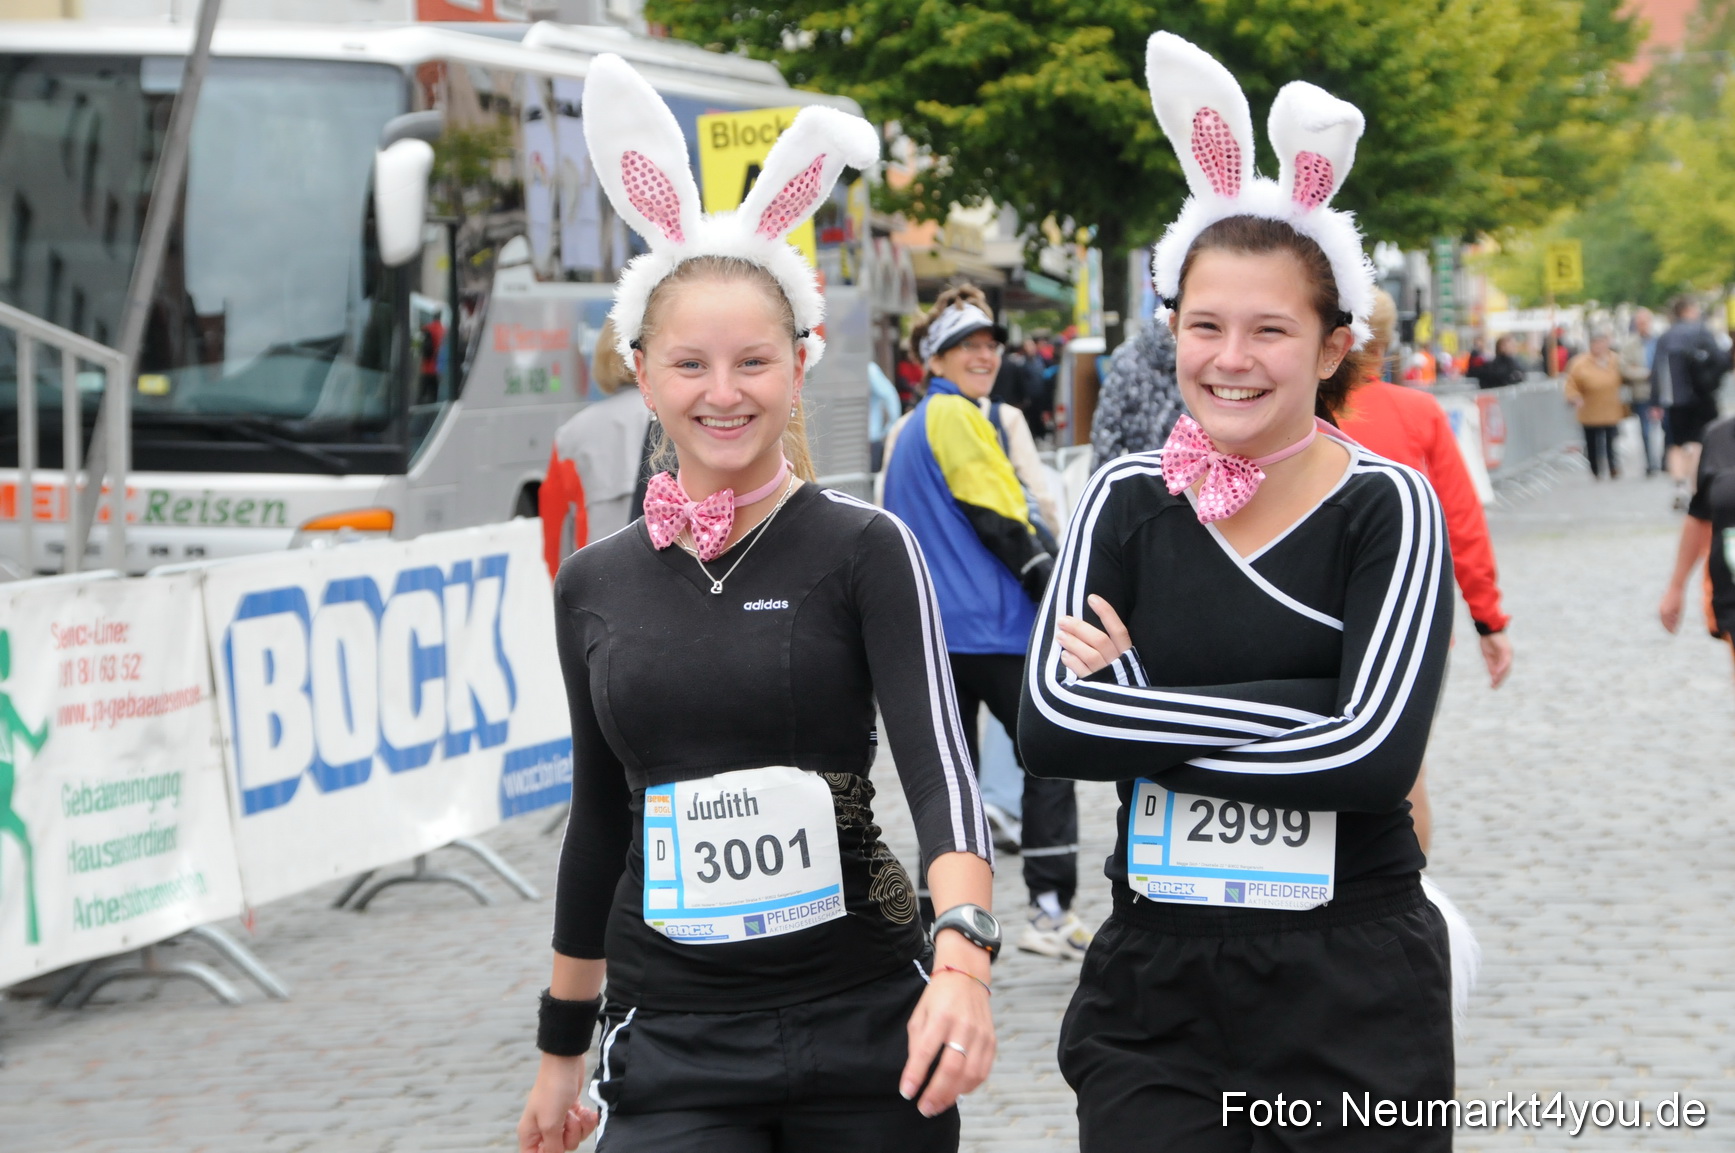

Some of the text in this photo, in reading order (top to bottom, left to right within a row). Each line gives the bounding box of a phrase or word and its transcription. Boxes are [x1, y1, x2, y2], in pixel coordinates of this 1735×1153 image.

[143, 488, 287, 525] Reisen
[743, 598, 790, 611] adidas
[222, 553, 516, 817] BOCK
[687, 788, 759, 821] Judith
[1145, 795, 1156, 816] D
[1187, 799, 1311, 848] 2999
[657, 839, 665, 861] D
[694, 828, 811, 884] 3001
[1148, 881, 1195, 895] BOCK
[1248, 882, 1328, 900] PFLEIDERER
[767, 895, 840, 925] PFLEIDERER
[665, 923, 714, 936] BOCK
